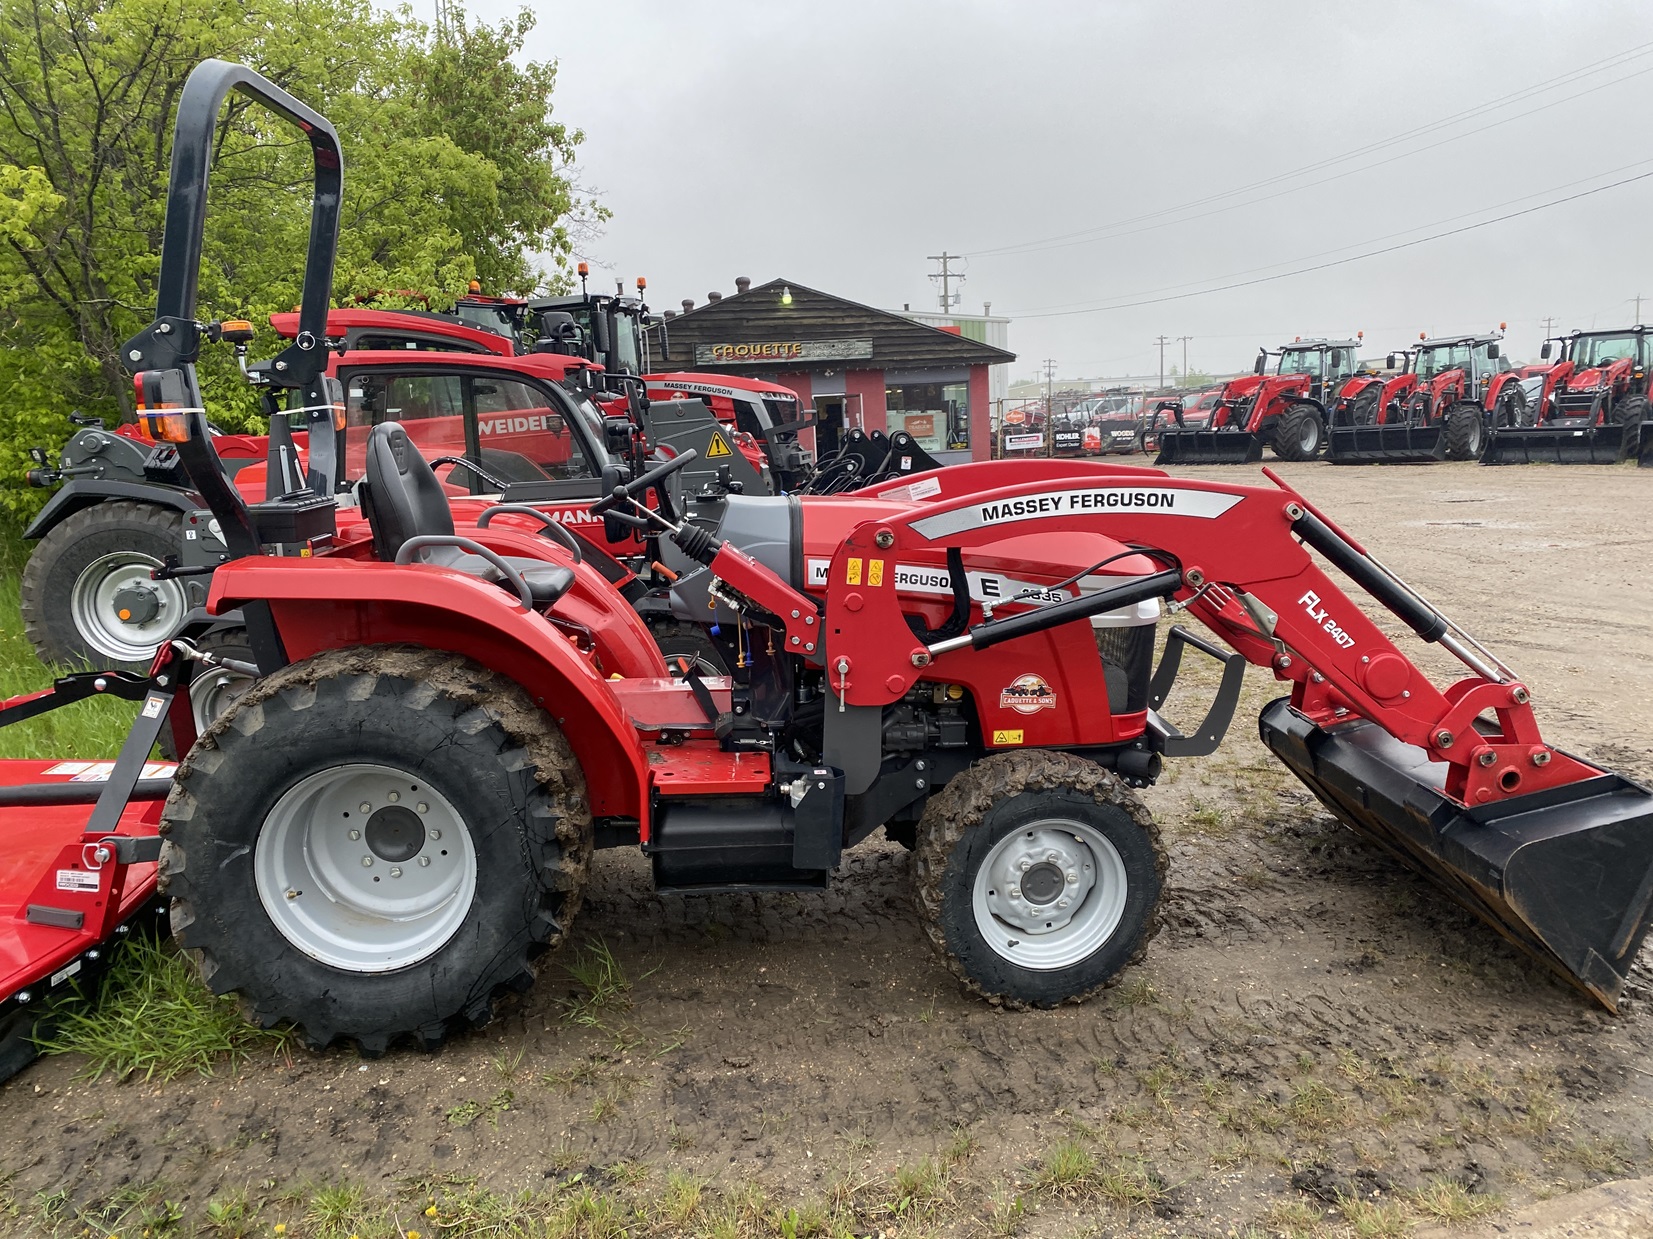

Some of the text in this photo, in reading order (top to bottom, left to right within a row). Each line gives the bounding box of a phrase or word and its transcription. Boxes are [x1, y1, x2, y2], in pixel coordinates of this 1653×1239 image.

[664, 382, 733, 396] MASSEY FERGUSON
[1056, 432, 1081, 441] KOHLER
[982, 492, 1175, 522] MASSEY FERGUSON
[1322, 619, 1356, 649] 2407
